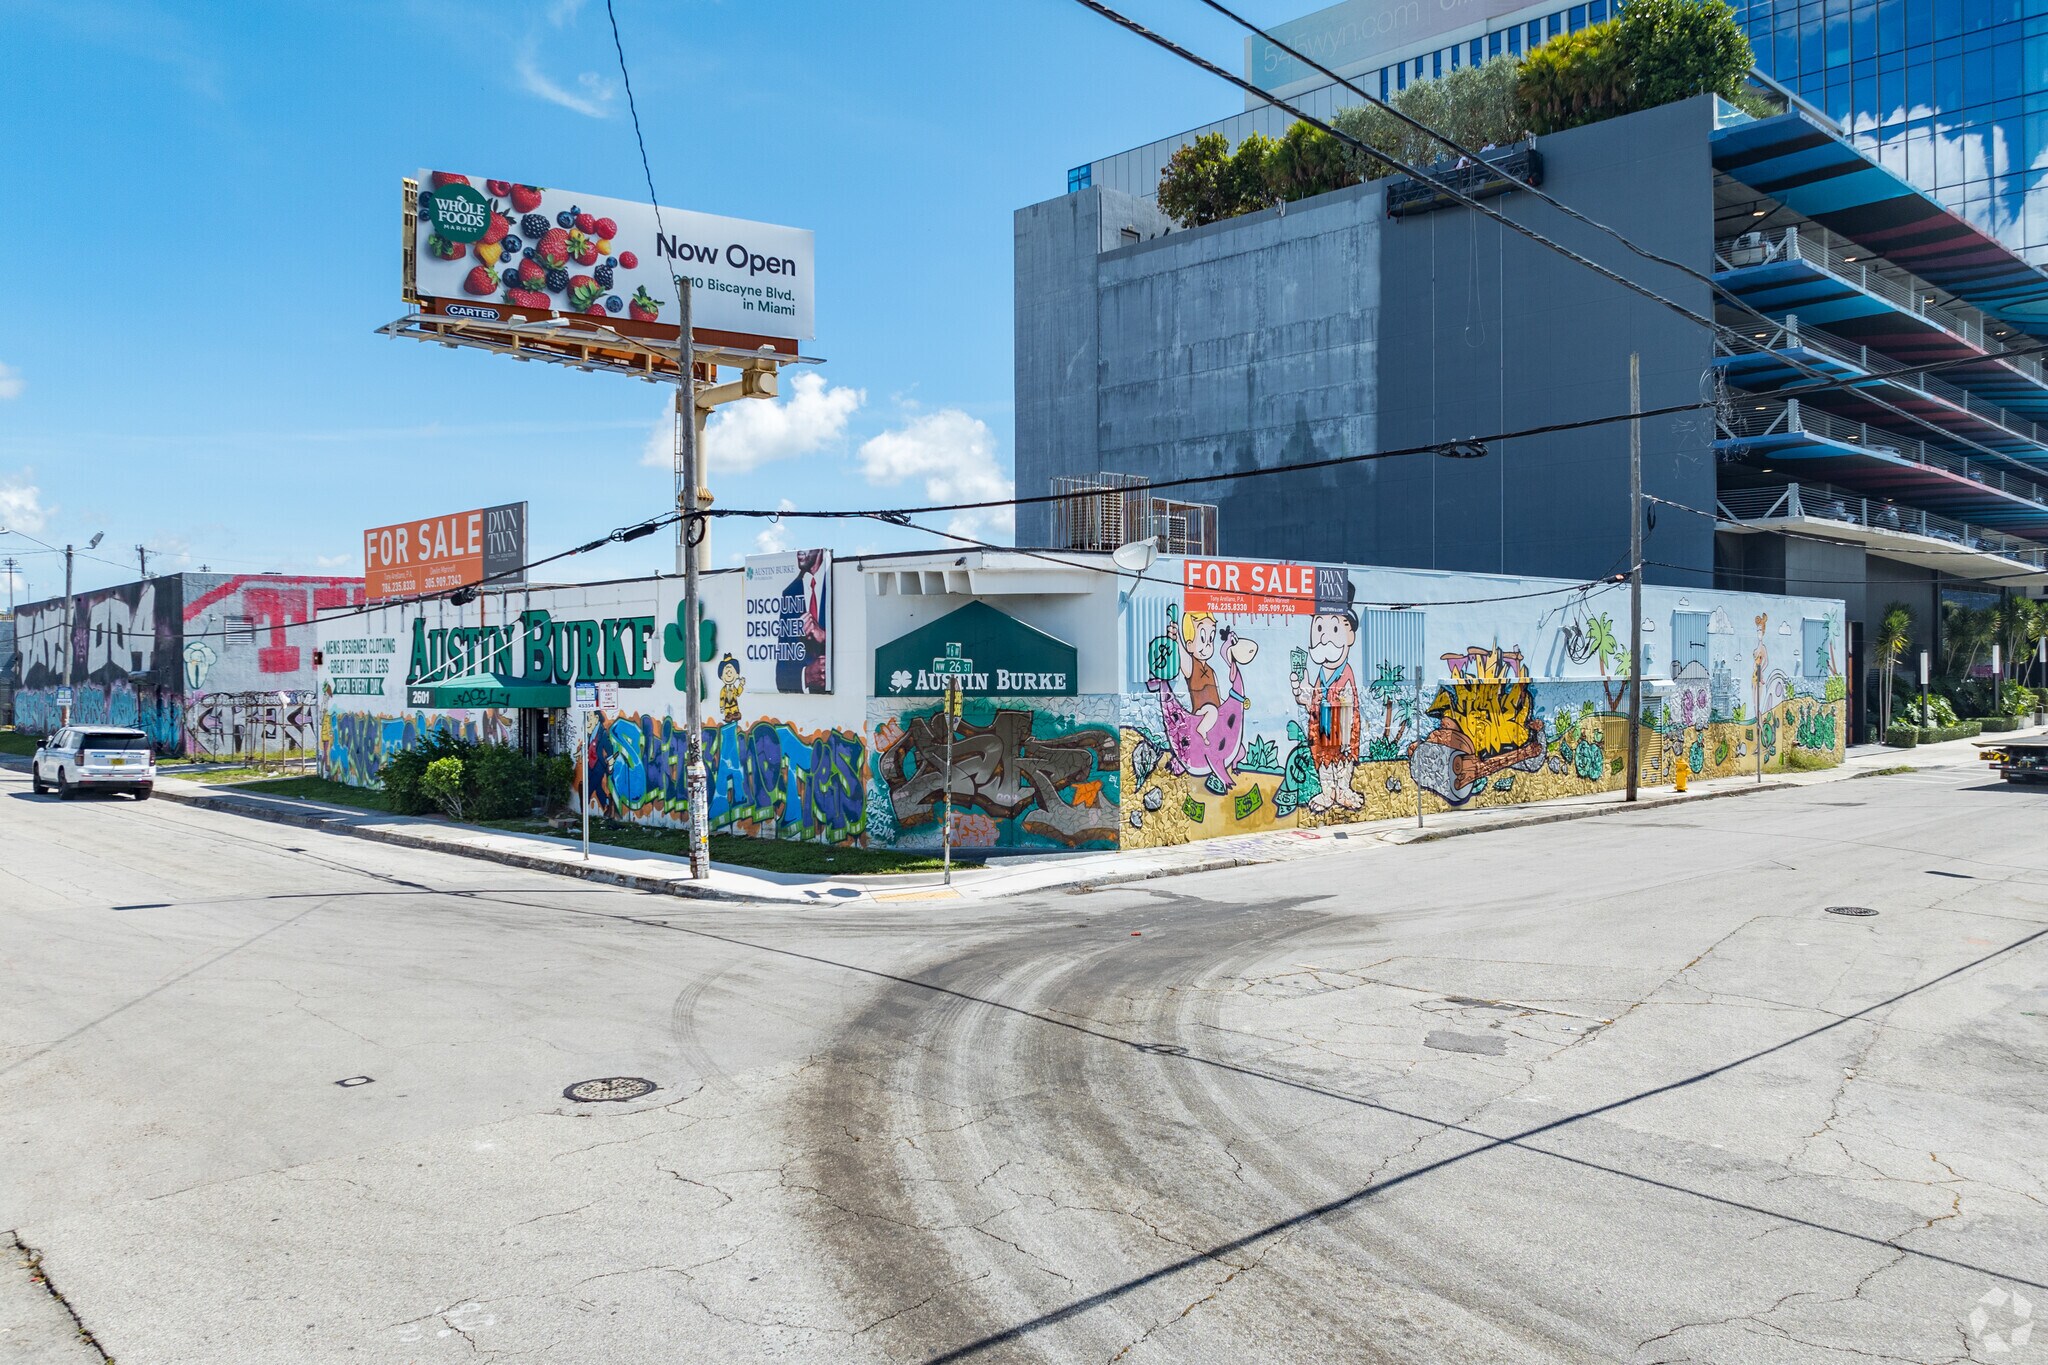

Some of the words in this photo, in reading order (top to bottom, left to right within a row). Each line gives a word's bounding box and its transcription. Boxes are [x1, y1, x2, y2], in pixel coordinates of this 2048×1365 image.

[1264, 0, 1419, 73] 545wyn.com
[435, 197, 486, 216] WHOLE
[438, 210, 485, 227] FOODS
[443, 224, 478, 233] MARKET
[656, 232, 719, 265] Now
[726, 244, 796, 276] Open
[673, 274, 704, 288] 210
[708, 278, 762, 297] Biscayne
[766, 286, 795, 301] Blvd.
[450, 306, 496, 318] CARTER
[743, 298, 754, 310] in
[758, 300, 795, 316] Miami
[488, 507, 518, 533] DWN
[366, 528, 409, 568] FOR
[418, 513, 481, 561] SALE
[488, 529, 518, 554] TWN
[755, 567, 775, 576] AUSTIN
[776, 565, 795, 574] BURKE
[1187, 562, 1240, 591] FOR
[1251, 566, 1313, 594] SALE
[1319, 570, 1344, 583] DWN
[1319, 583, 1344, 597] TWN
[747, 595, 805, 614] DISCOUNT
[1207, 602, 1248, 611] 786.235.8330
[747, 618, 806, 637] DESIGNER
[342, 639, 367, 654] DESIGNER
[369, 637, 396, 654] CLOTHING
[406, 617, 515, 685] AUSTIN
[519, 610, 655, 687] BURKE
[747, 642, 806, 661] CLOTHING
[330, 659, 345, 673] GREAT
[360, 659, 373, 673] COST
[375, 658, 390, 673] LESS
[950, 661, 961, 673] 26
[964, 664, 971, 672] ST
[336, 678, 351, 694] OPEN
[351, 678, 369, 694] EVERY
[370, 678, 380, 694] DAY
[915, 669, 989, 690] AUSTIN
[996, 668, 1067, 690] BURKE
[412, 690, 430, 704] 2601
